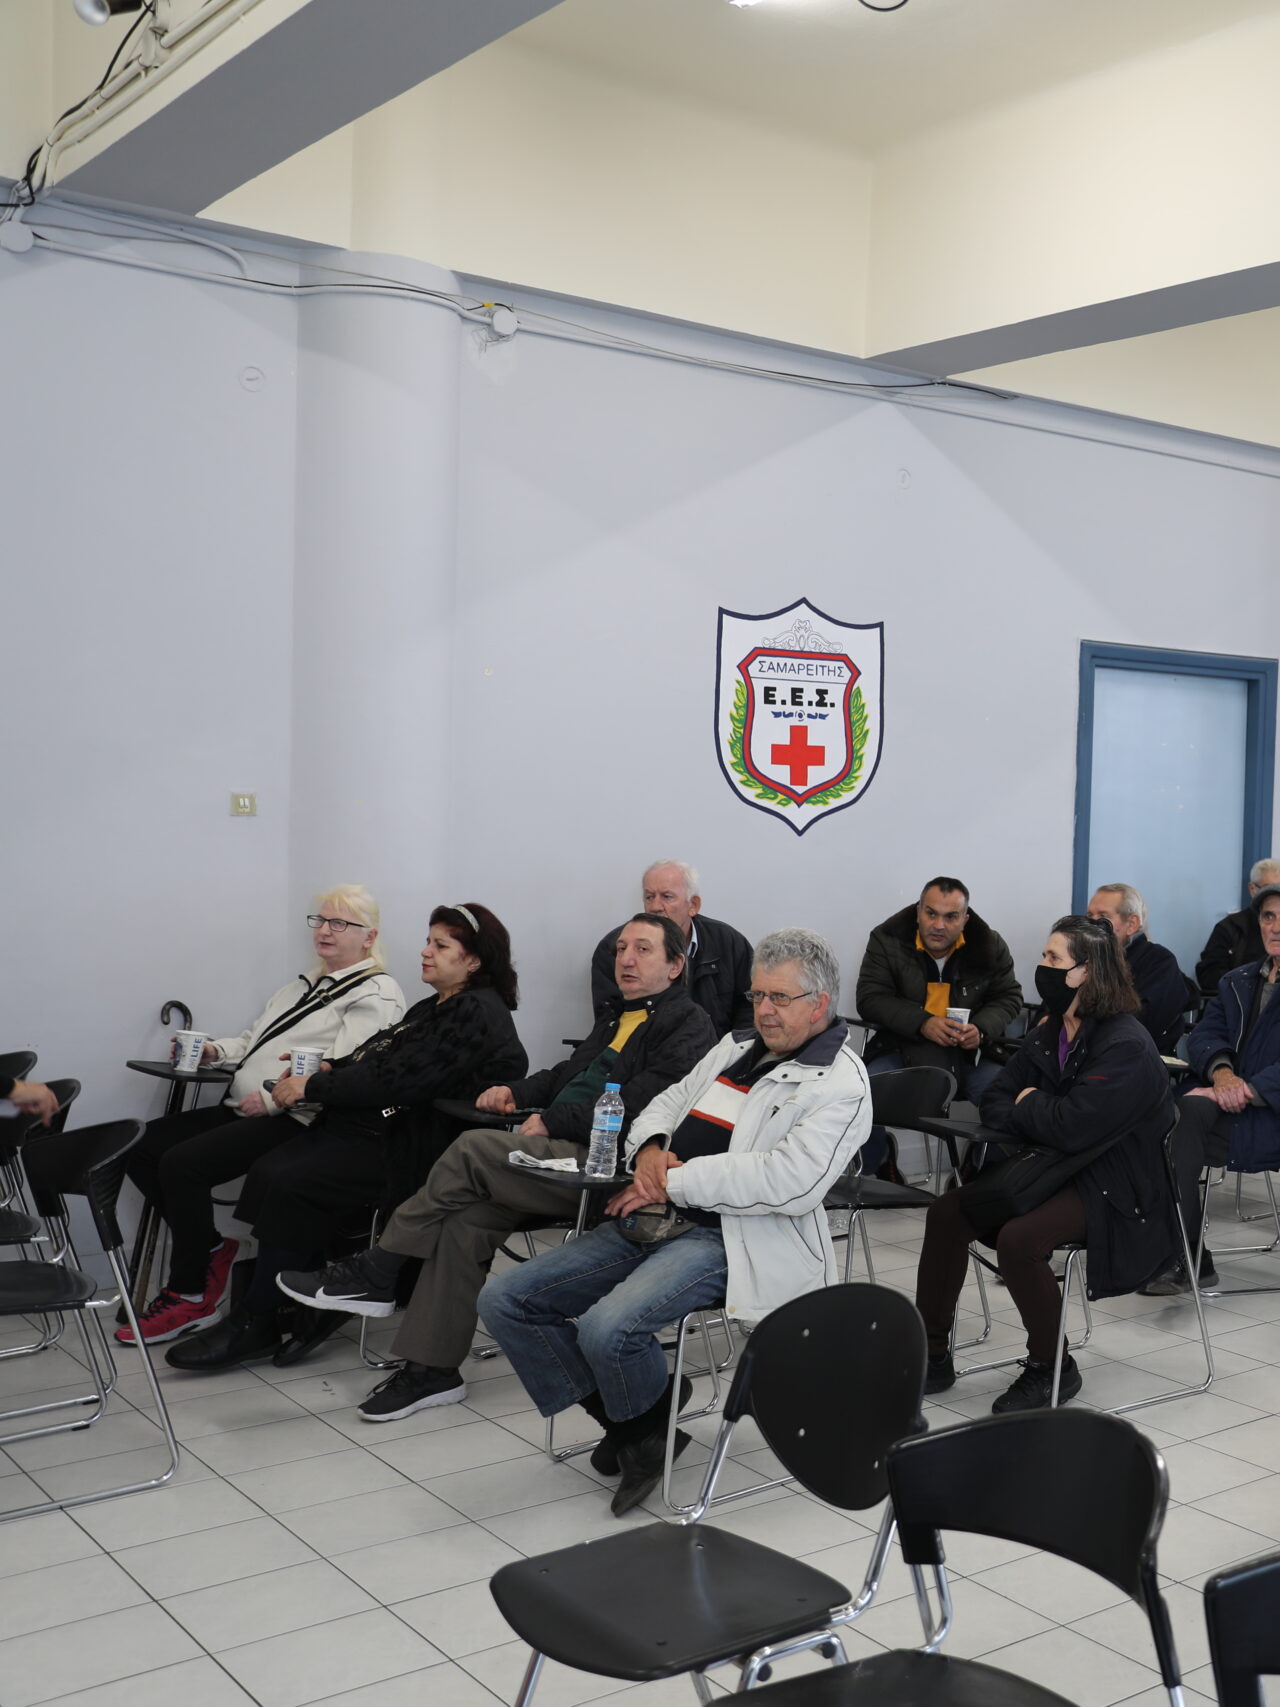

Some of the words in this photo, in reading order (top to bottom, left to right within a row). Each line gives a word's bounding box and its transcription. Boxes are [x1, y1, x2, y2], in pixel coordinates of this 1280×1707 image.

[758, 661, 845, 678] ΣΑΜΑΡΕΙΤΗΣ
[763, 686, 836, 708] Ε.Ε.Σ.
[191, 1037, 202, 1057] LIFE
[296, 1054, 305, 1075] LIFE
